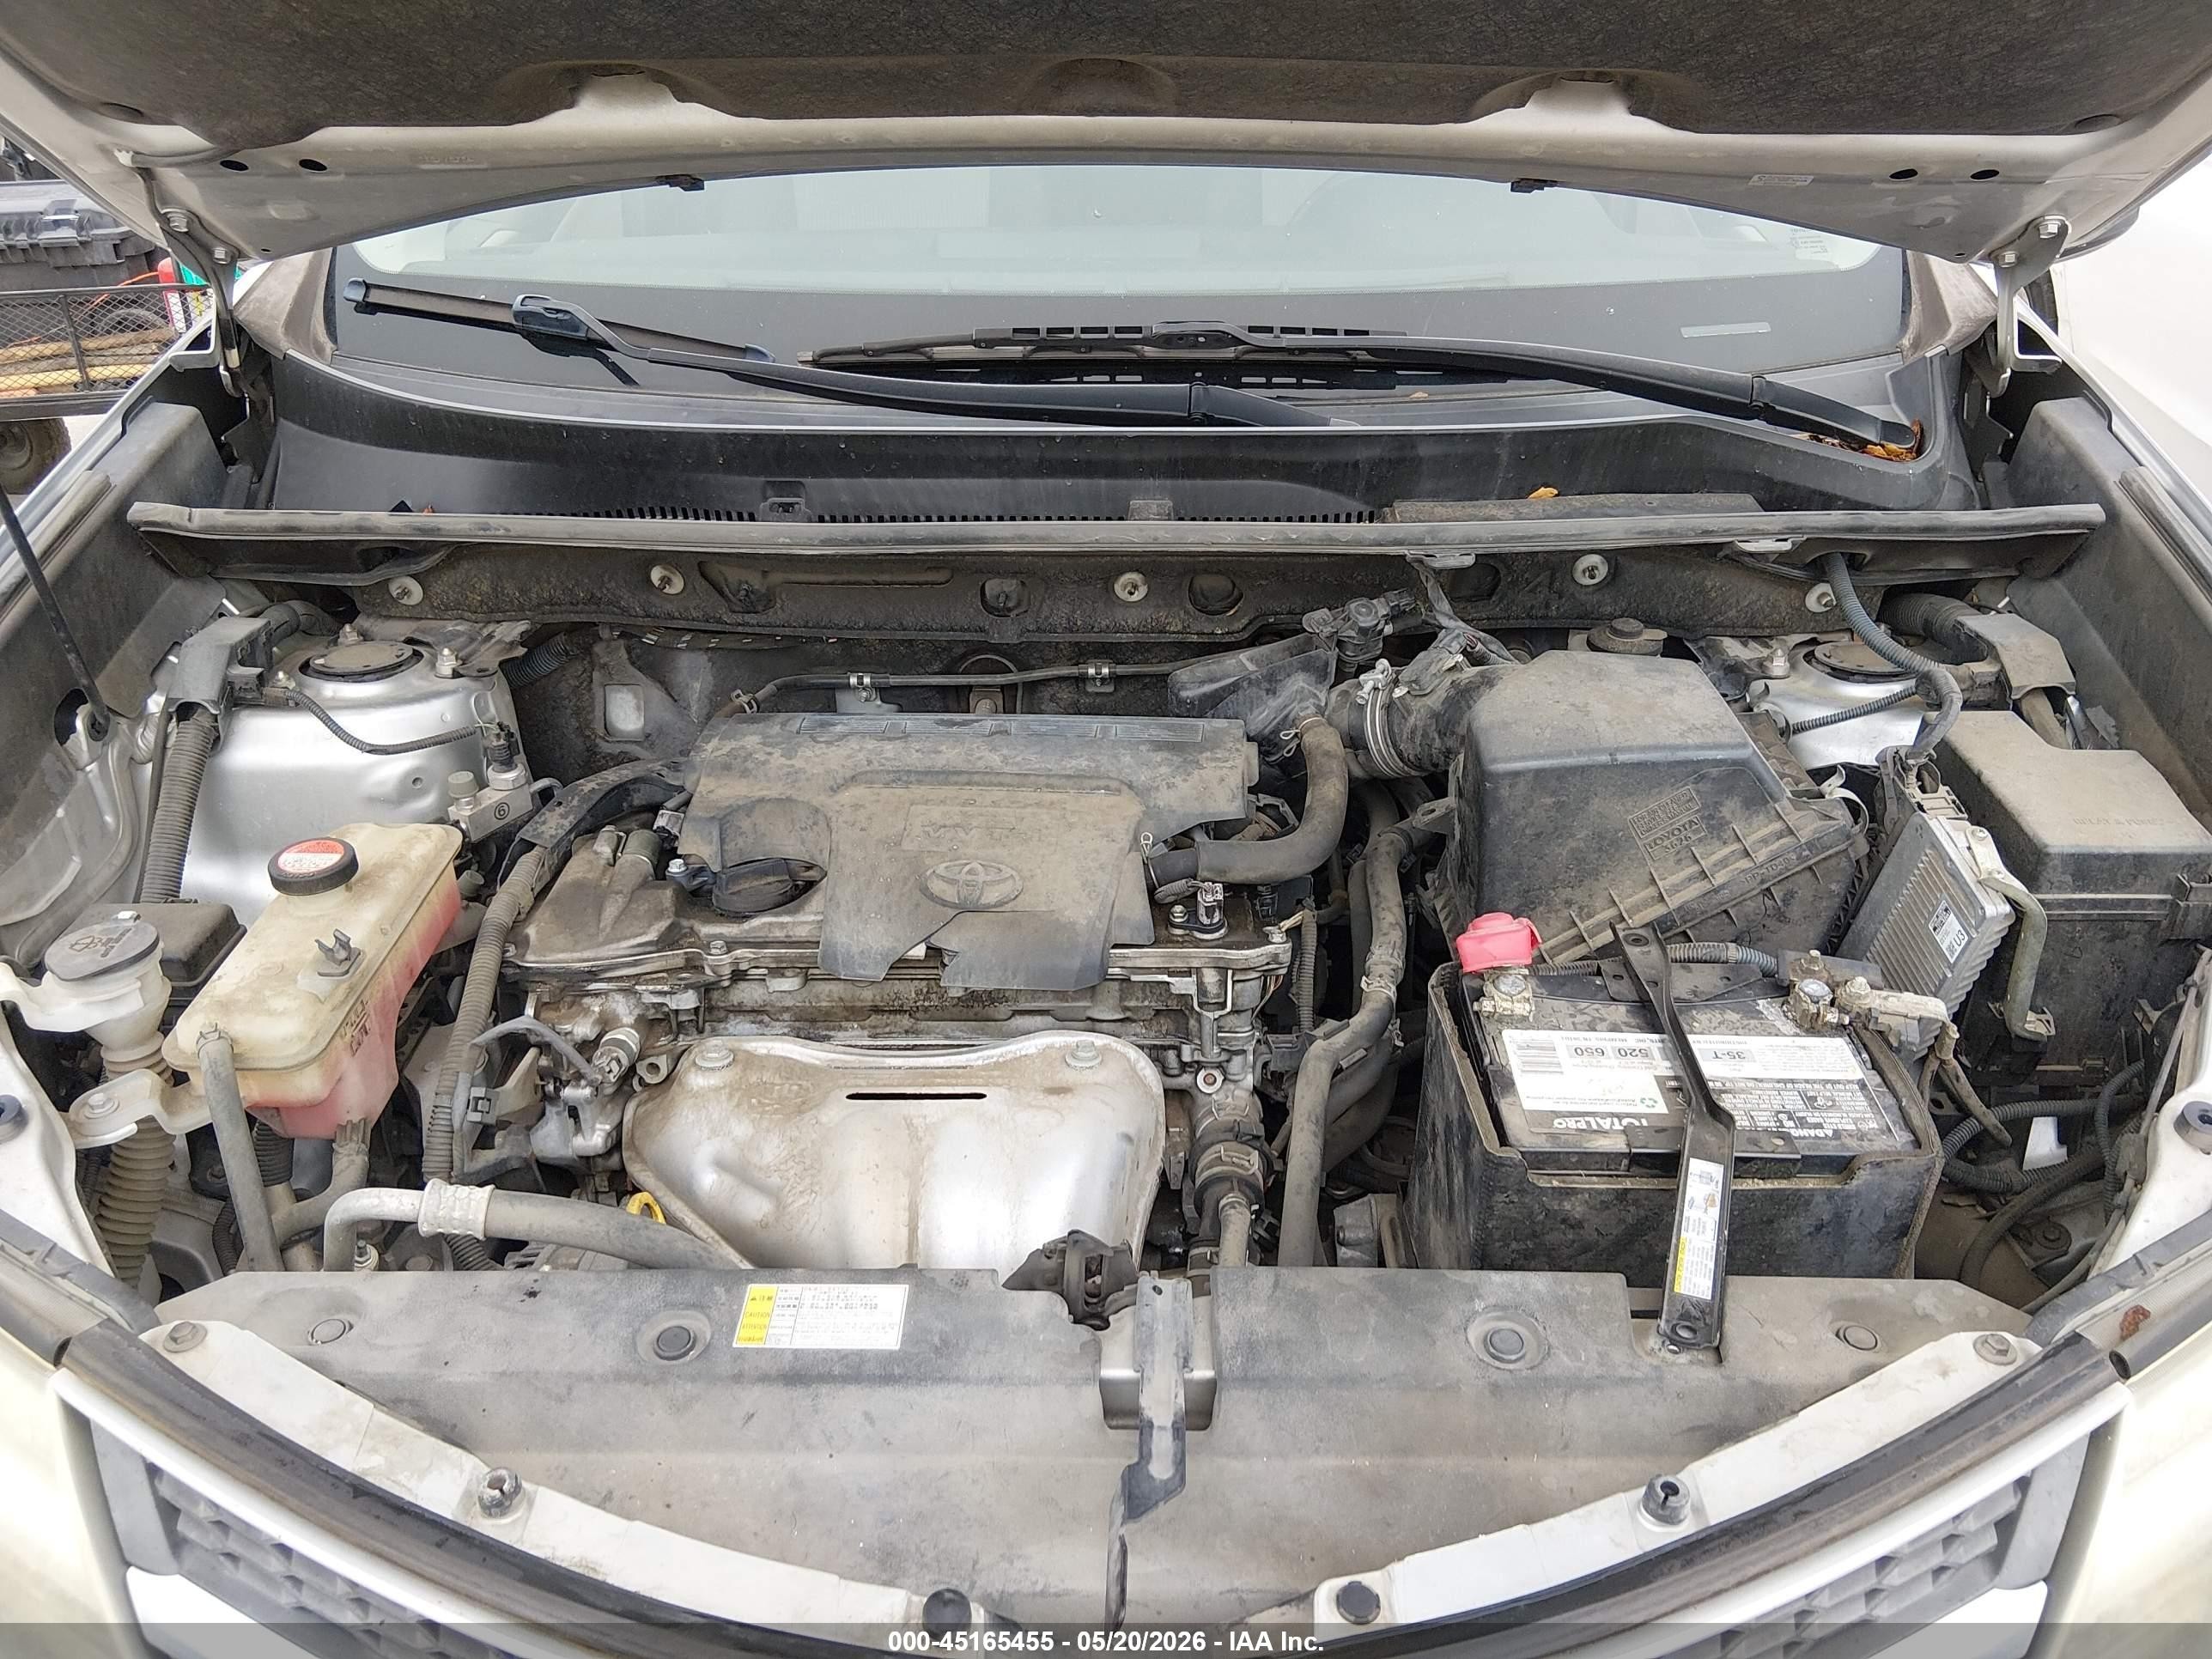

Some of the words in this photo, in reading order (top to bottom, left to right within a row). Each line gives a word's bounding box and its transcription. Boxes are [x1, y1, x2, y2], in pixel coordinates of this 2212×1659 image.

[1646, 816, 1700, 849] TOYOTA
[1573, 1047, 1605, 1057] 650
[1617, 1047, 1650, 1058] 520
[1711, 1050, 1747, 1060] 35-T
